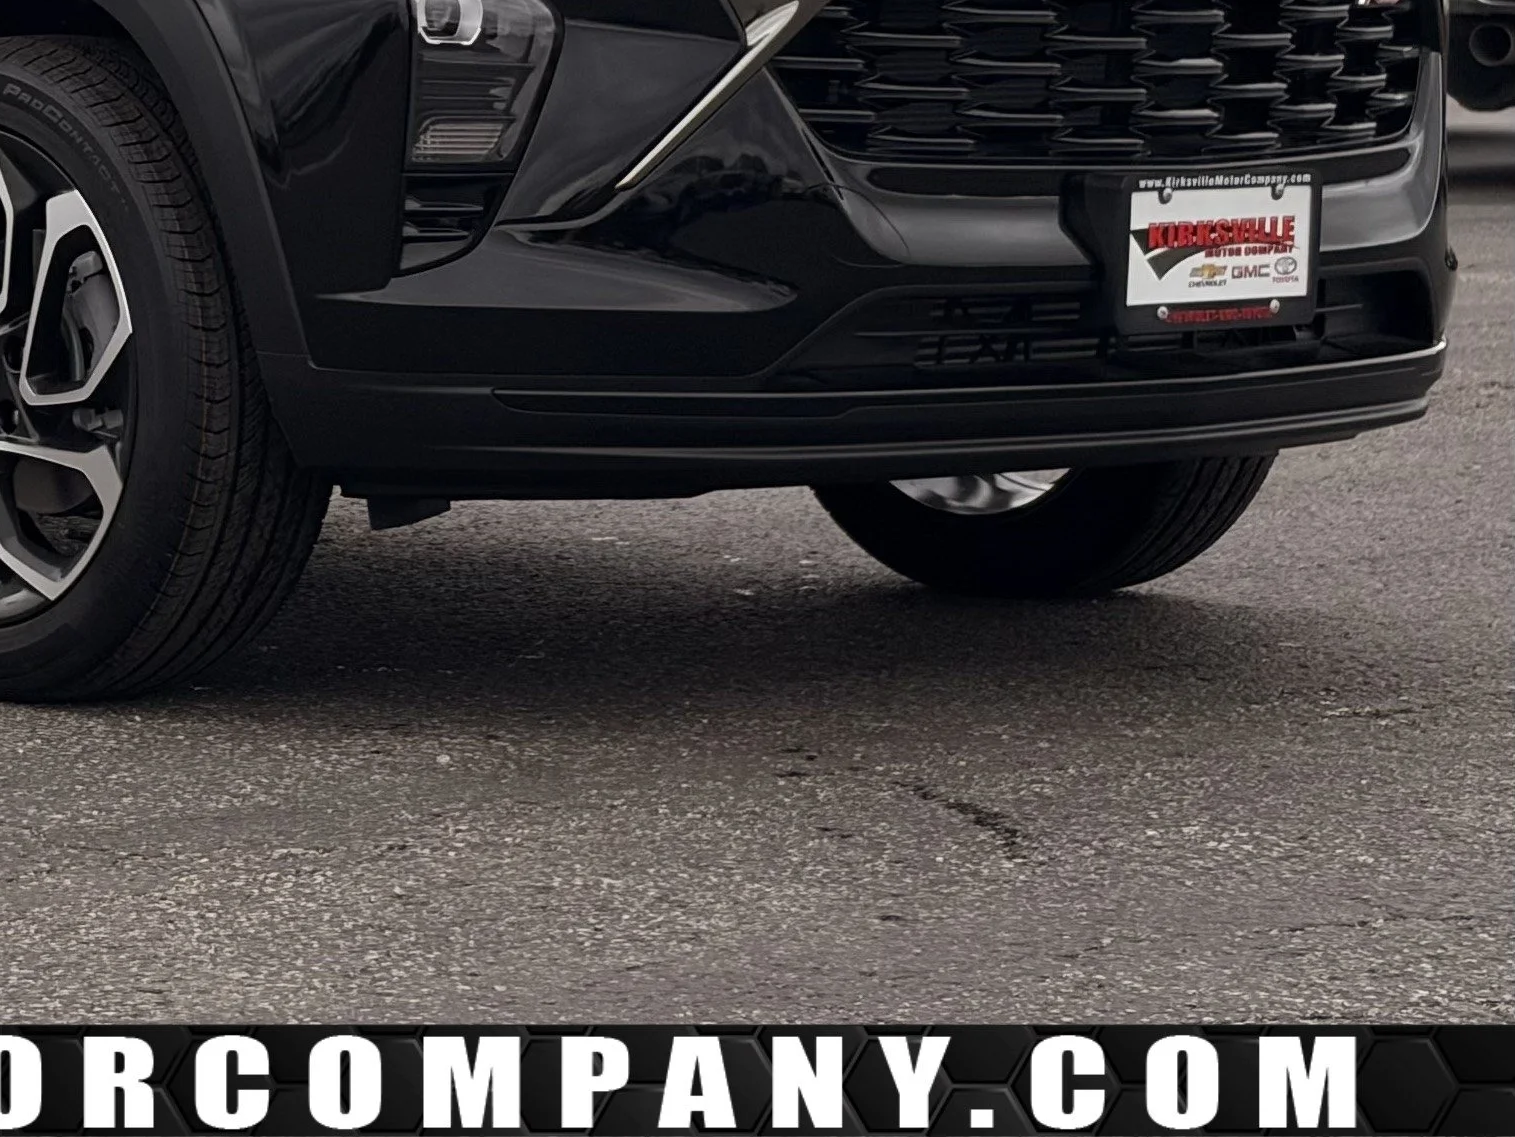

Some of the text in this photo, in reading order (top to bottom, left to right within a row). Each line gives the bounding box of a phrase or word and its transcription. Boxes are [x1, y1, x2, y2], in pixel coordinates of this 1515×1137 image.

[1148, 216, 1295, 249] KIRKSVILLE
[1204, 244, 1294, 258] MOTOR COMPANY
[1231, 264, 1270, 280] GMC
